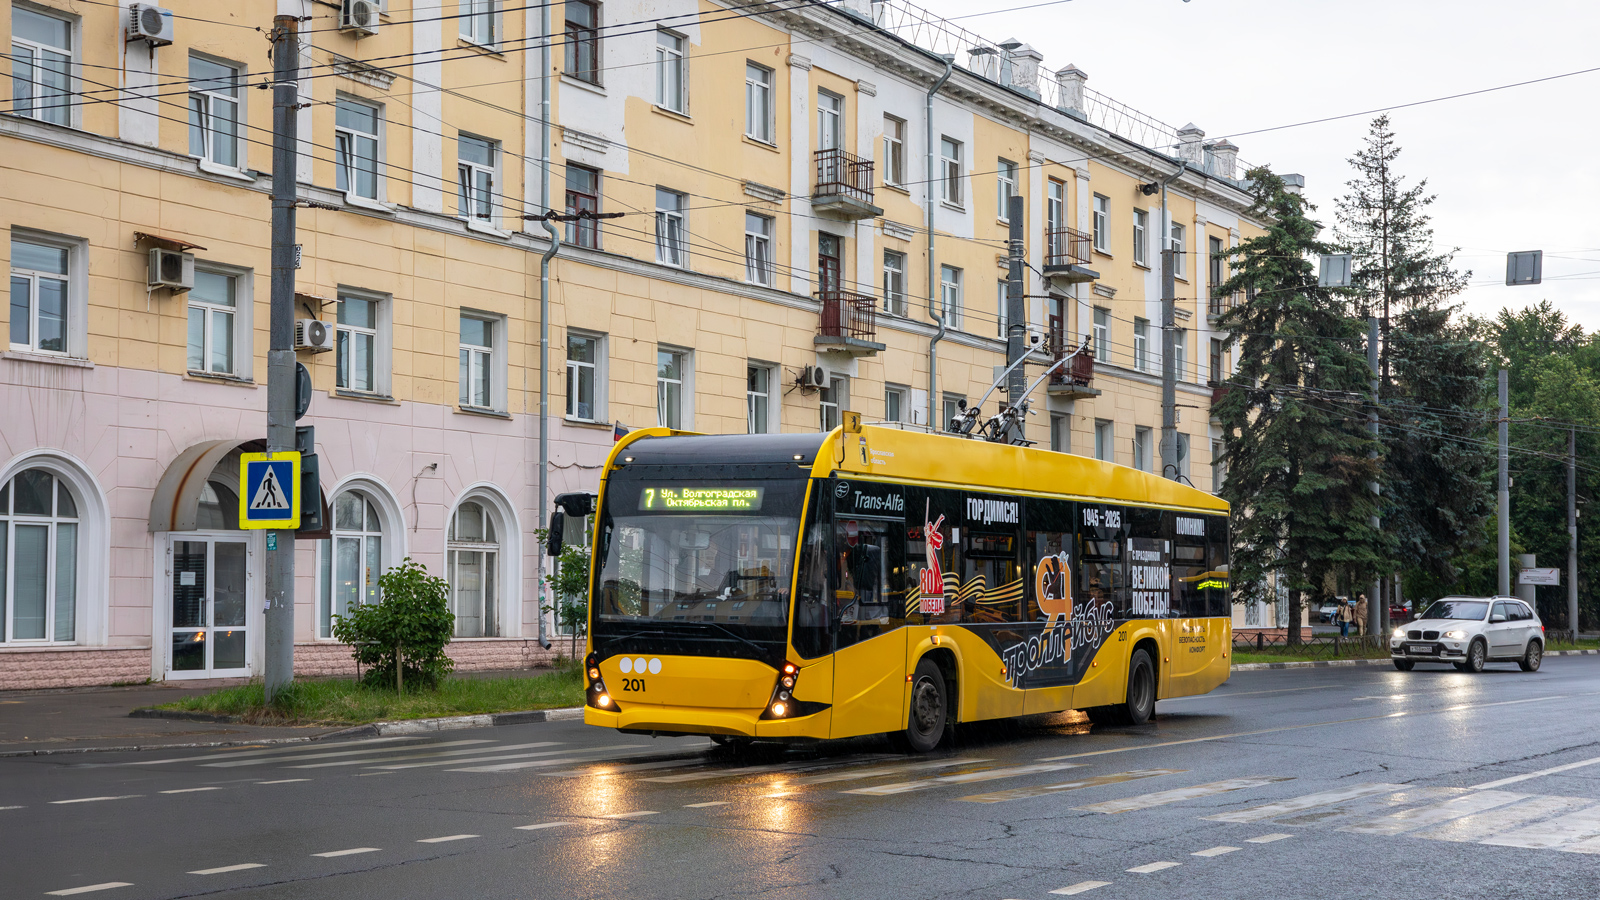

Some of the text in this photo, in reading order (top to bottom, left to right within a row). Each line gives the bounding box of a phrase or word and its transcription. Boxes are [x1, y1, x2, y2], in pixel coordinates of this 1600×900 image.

[870, 457, 886, 465] область
[645, 488, 655, 508] 7
[661, 488, 757, 499] Ул. Волгоградская
[666, 498, 750, 508] Октябрьская пл.
[854, 490, 904, 512] Trans-Alfa
[966, 497, 1019, 526] ГОРДИМСЯ!
[1083, 508, 1099, 527] 1945
[1105, 510, 1121, 529] 2025
[1176, 516, 1205, 536] ПОМНИМ!
[920, 568, 934, 594] 80
[1132, 563, 1170, 590] ВЕЛИКОЙ
[920, 598, 945, 615] ПОБЕДА!
[1132, 591, 1170, 619] ПОБЕДЫ!
[1118, 631, 1127, 641] 201
[622, 678, 646, 692] 201
